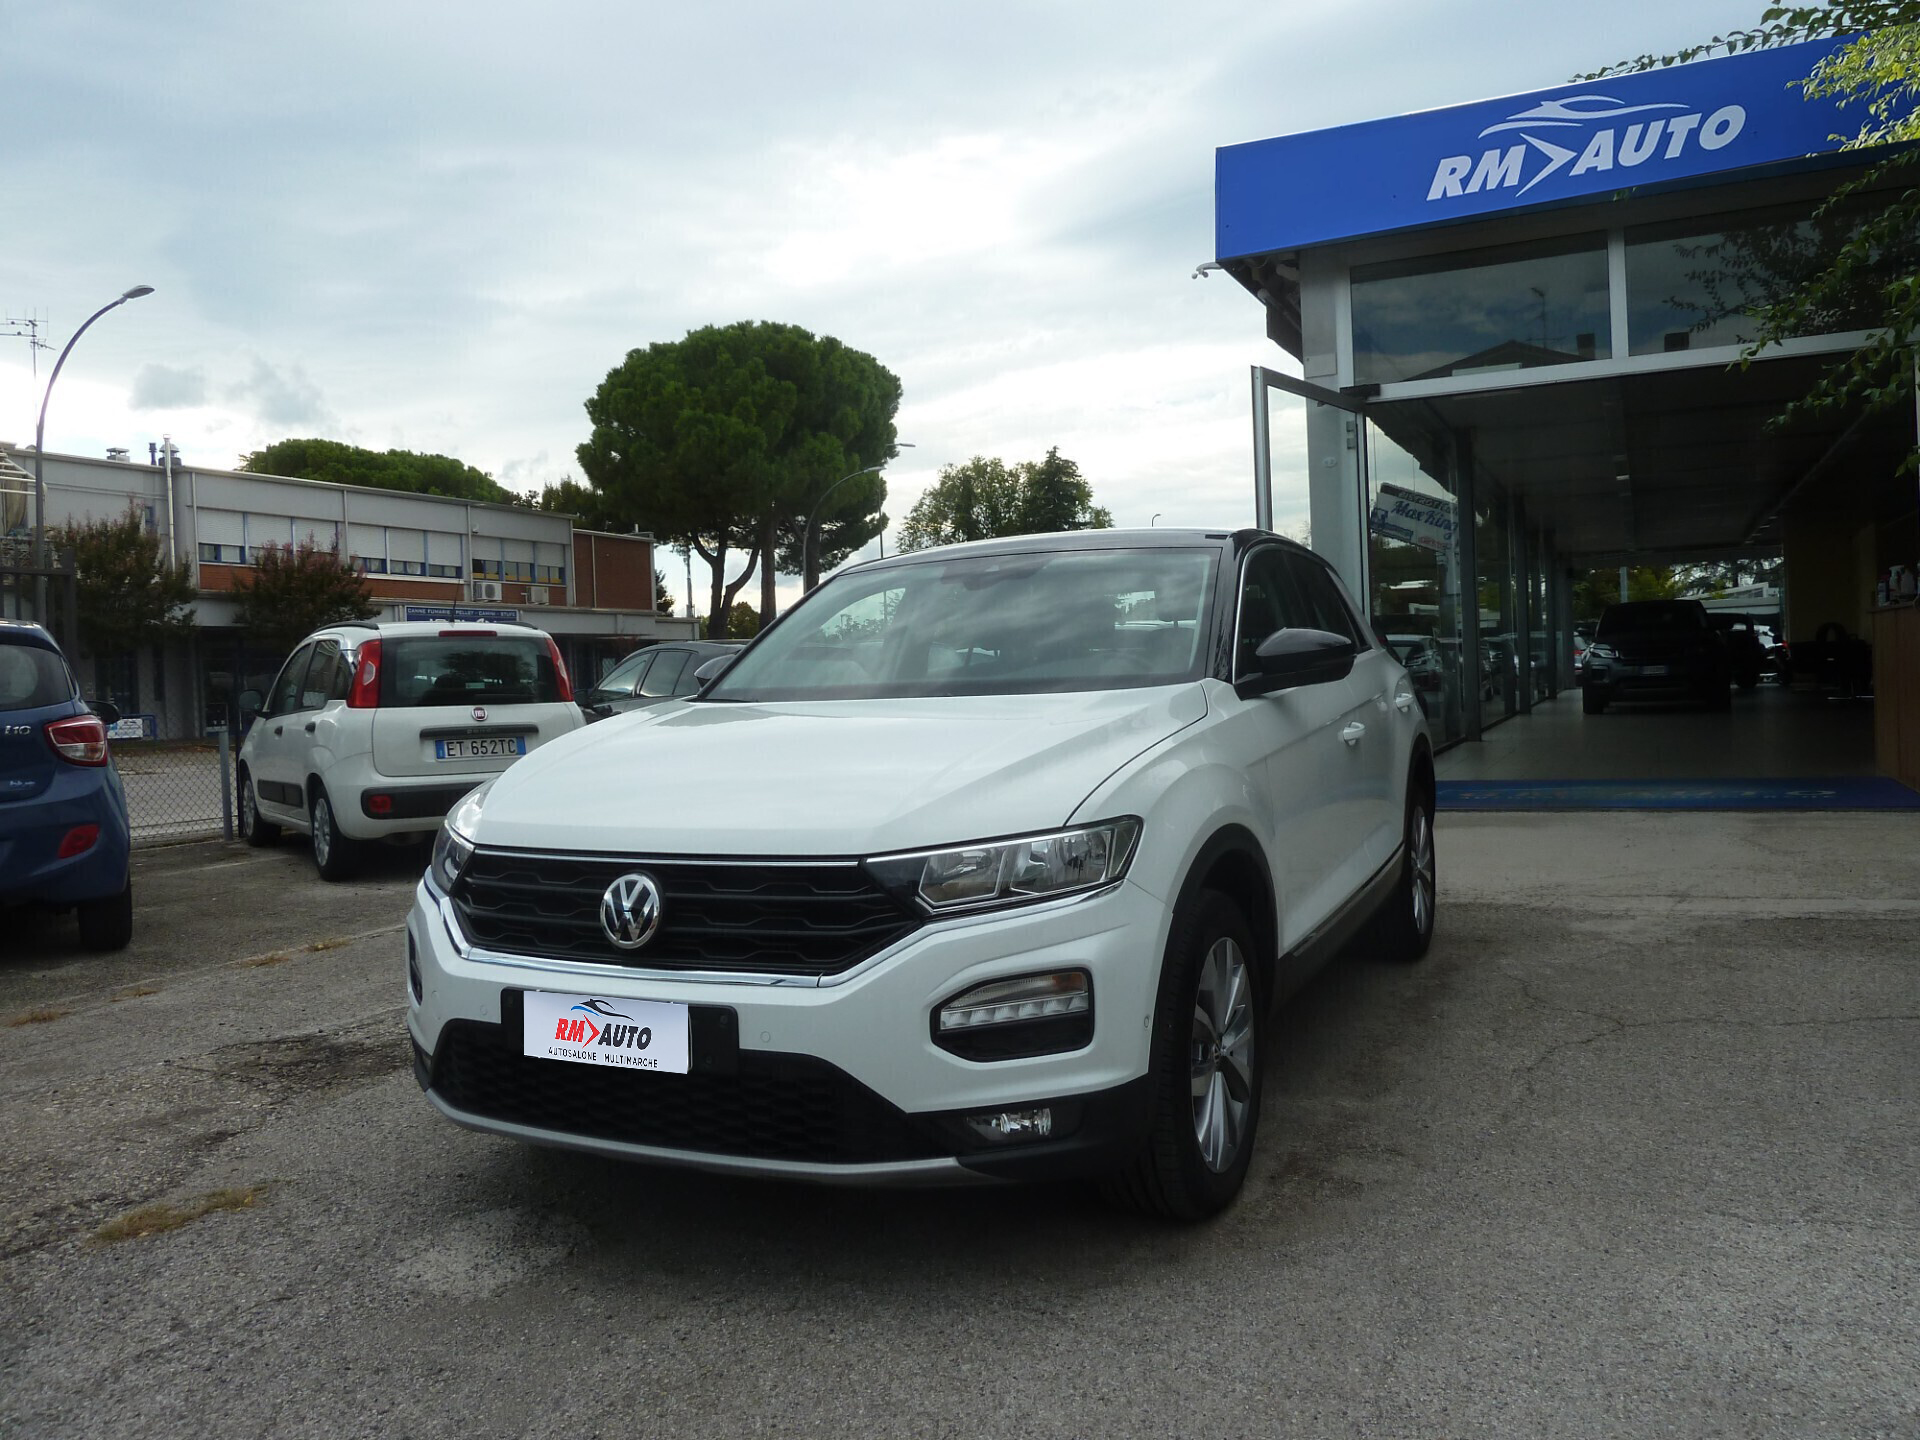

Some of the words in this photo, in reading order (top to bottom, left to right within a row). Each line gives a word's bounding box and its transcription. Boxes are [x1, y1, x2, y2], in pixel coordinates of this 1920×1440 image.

[1426, 144, 1526, 201] RM
[1567, 104, 1747, 177] AUTO
[446, 740, 466, 757] ET
[470, 739, 516, 756] 652TC
[554, 1017, 586, 1043] RM
[598, 1022, 653, 1051] AUTO
[547, 1046, 598, 1061] AUTOSALONE
[604, 1054, 659, 1069] MULTIMARCHE
